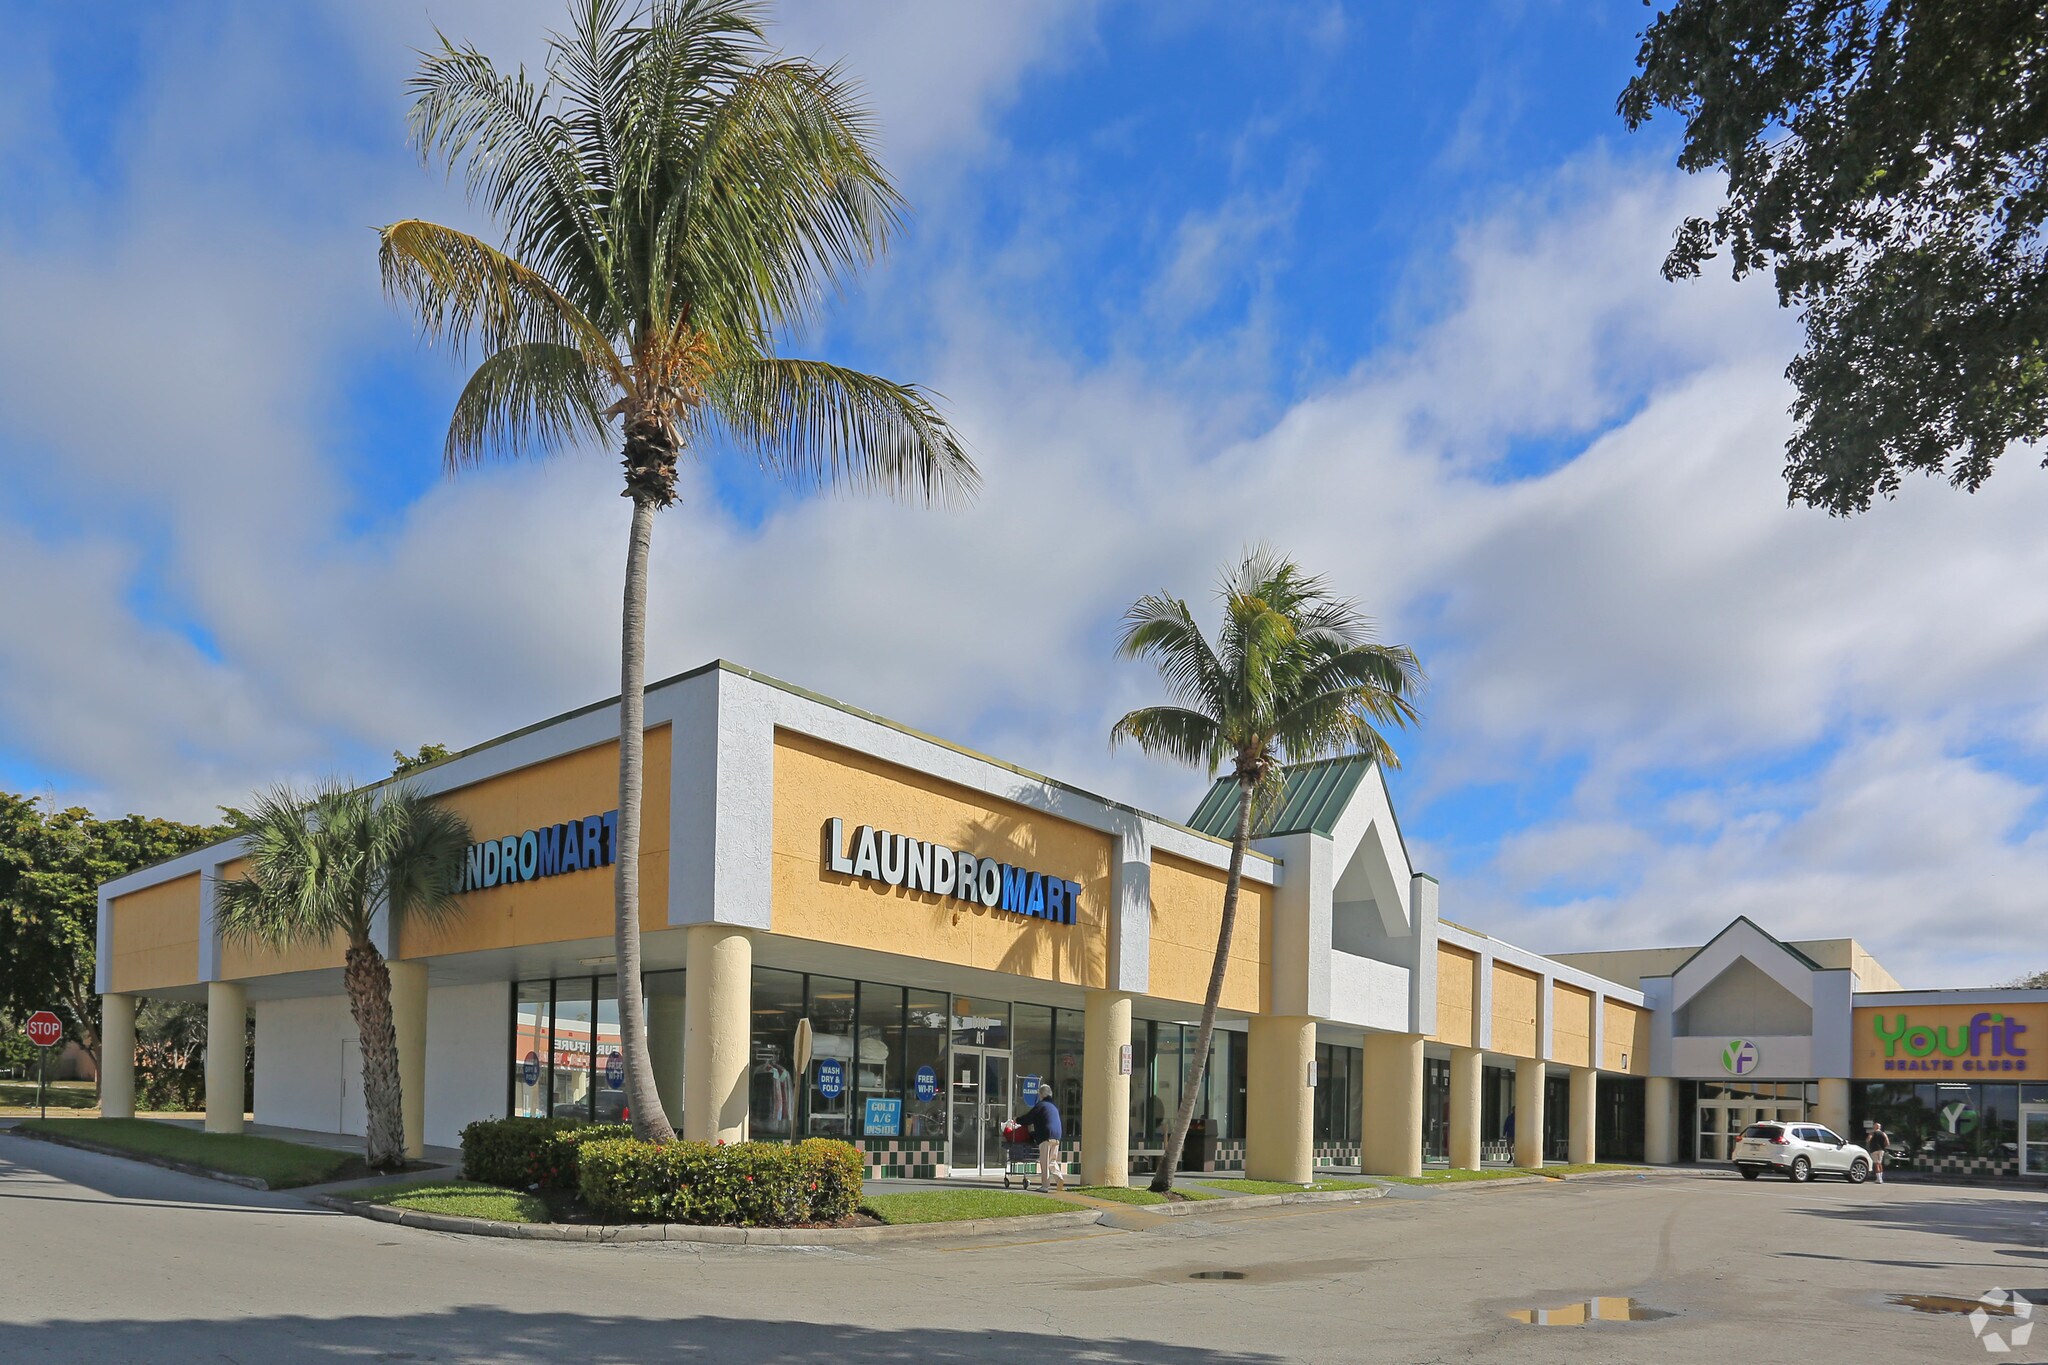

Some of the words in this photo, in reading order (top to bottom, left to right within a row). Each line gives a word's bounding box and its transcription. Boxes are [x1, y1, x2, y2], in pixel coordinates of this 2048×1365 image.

[829, 816, 1081, 926] LAUNDROMART
[30, 1021, 60, 1036] STOP
[976, 1031, 985, 1045] A1
[1884, 1059, 1954, 1071] HEALTH
[1962, 1059, 2027, 1071] CLUBS
[822, 1066, 840, 1075] WASH
[821, 1076, 833, 1084] DRY
[835, 1076, 840, 1084] &
[918, 1075, 934, 1084] FREE
[822, 1084, 839, 1092] FOLD
[918, 1085, 934, 1093] WI-FI
[866, 1125, 897, 1135] INSIDE
